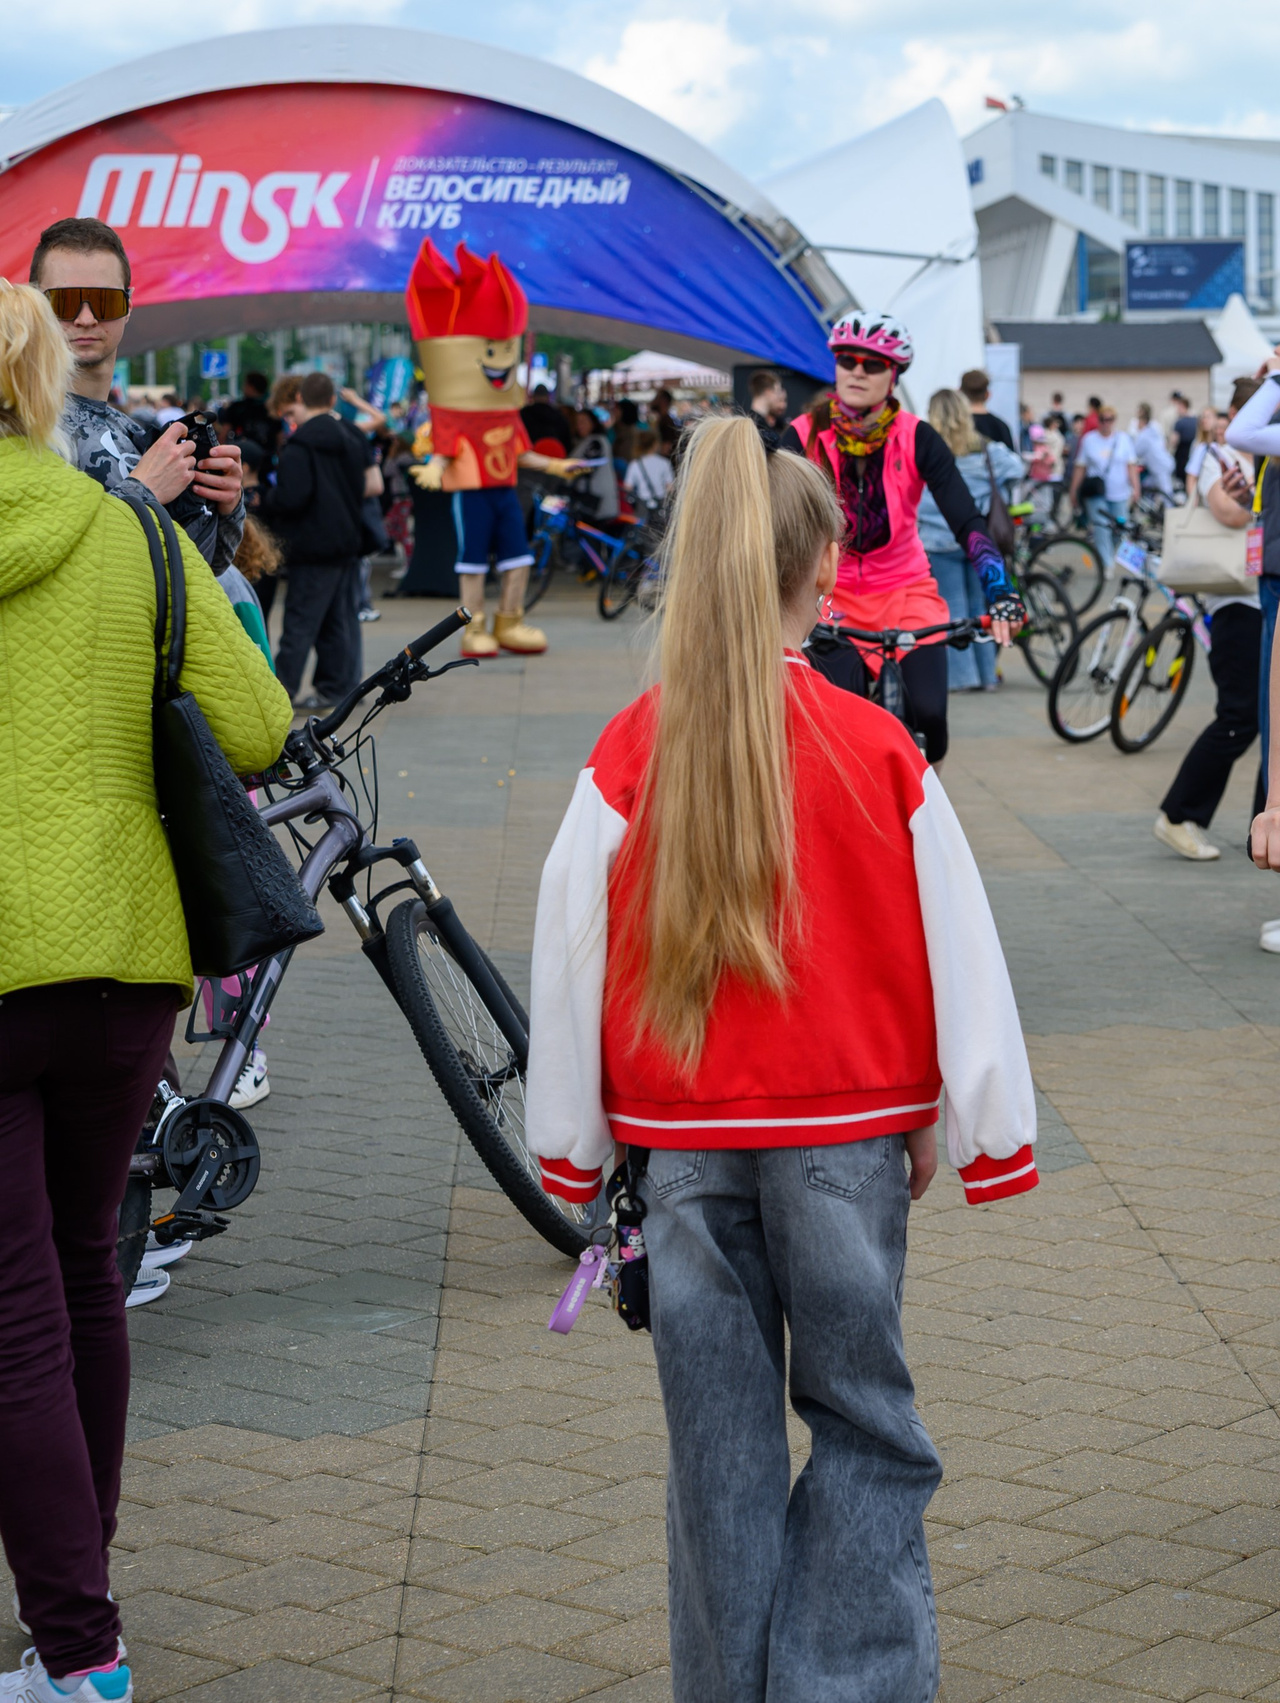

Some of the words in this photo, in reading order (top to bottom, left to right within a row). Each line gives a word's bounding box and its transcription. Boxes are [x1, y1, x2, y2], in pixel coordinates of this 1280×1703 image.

[384, 173, 631, 208] ВЕЛОСИПЕДНЫЙ
[76, 154, 350, 264] Minsk
[376, 202, 462, 229] КЛУБ
